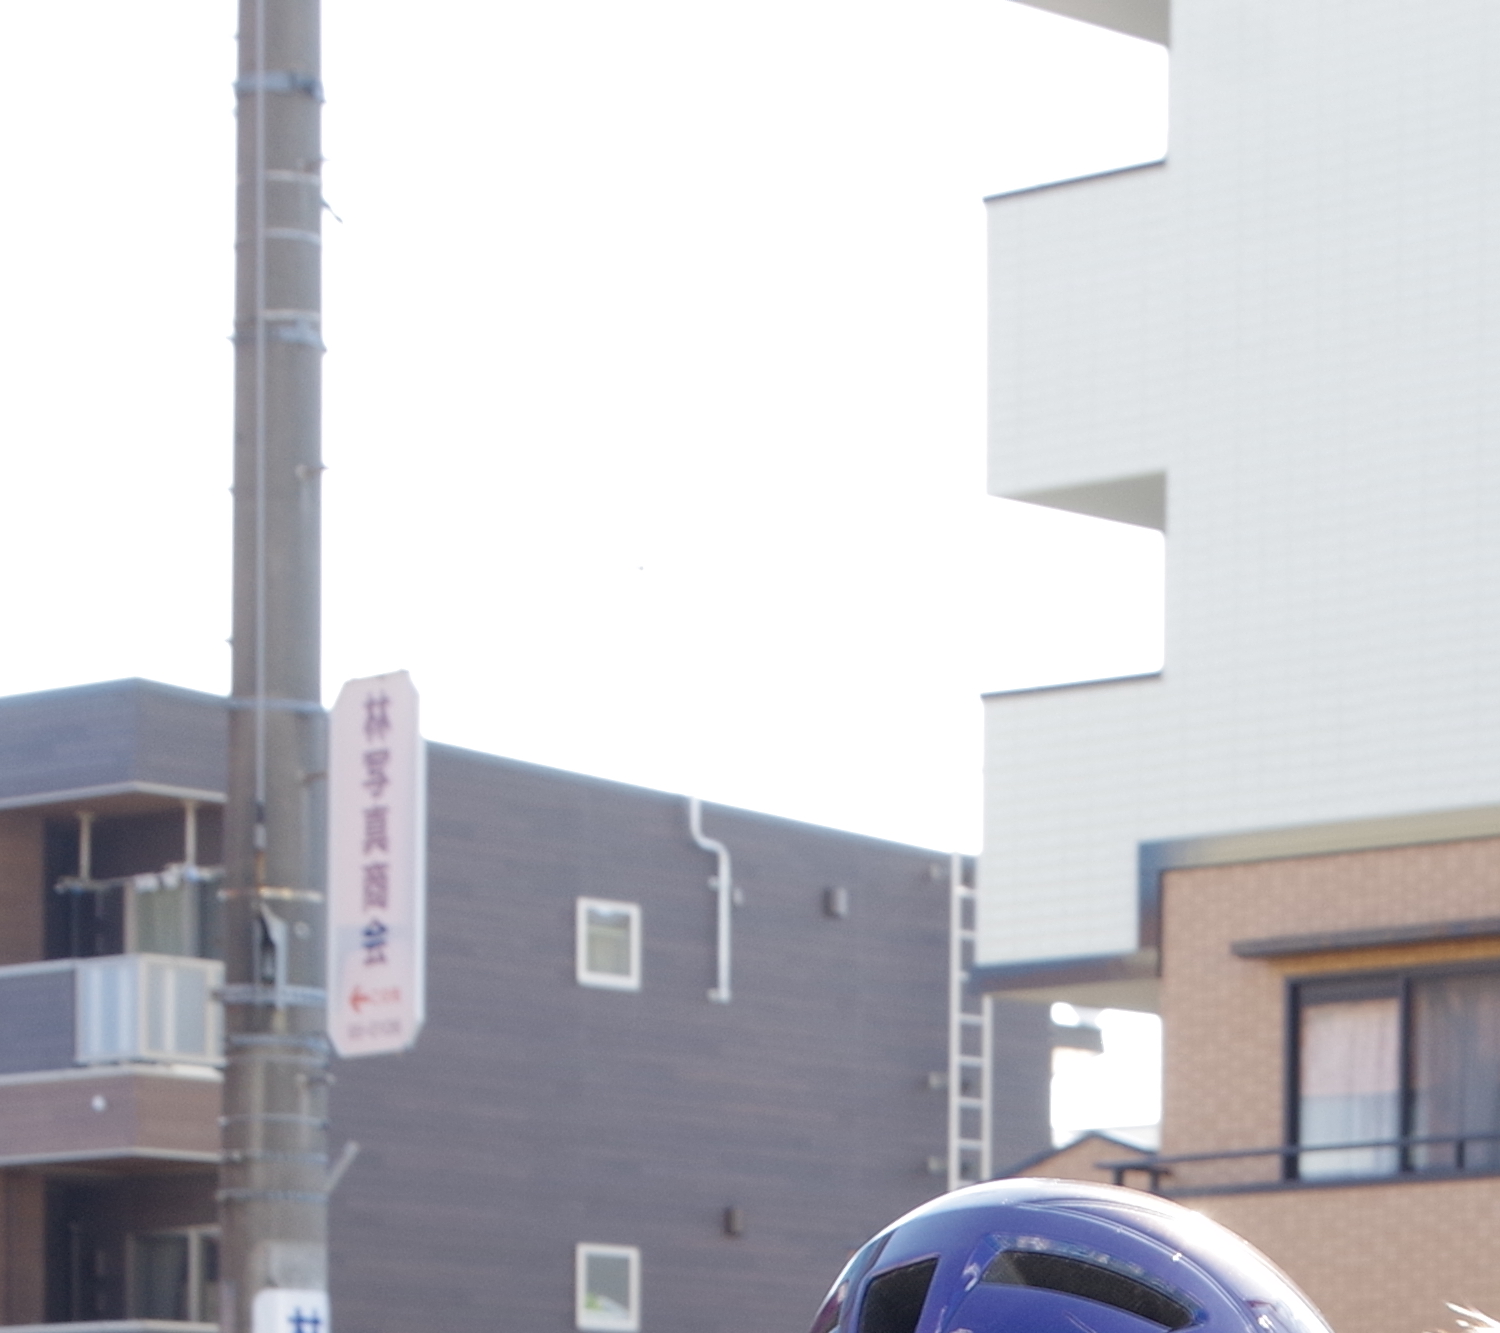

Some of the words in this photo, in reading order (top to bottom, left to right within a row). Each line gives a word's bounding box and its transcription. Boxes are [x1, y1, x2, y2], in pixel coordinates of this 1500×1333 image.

[362, 692, 392, 966] 林写真商会
